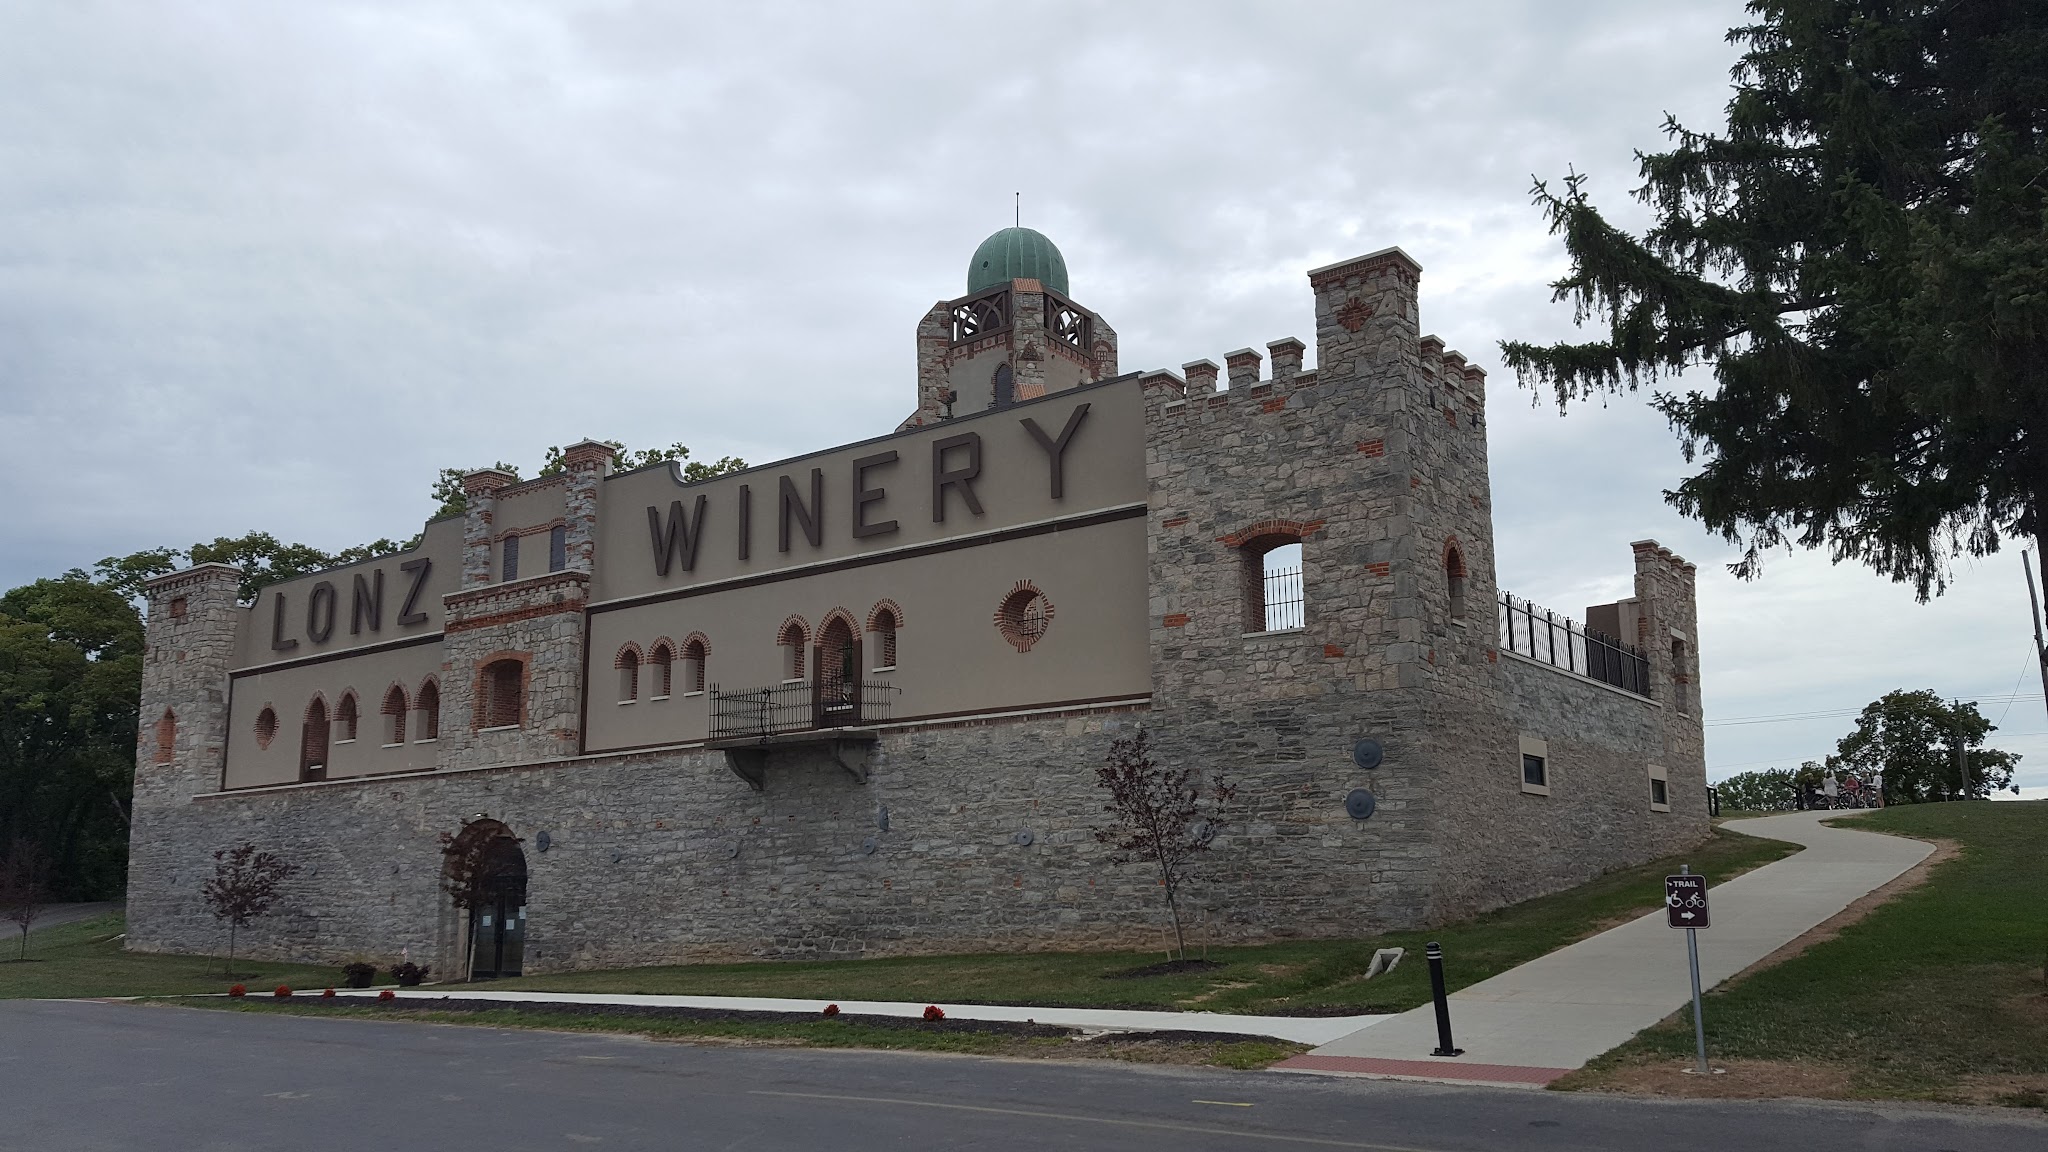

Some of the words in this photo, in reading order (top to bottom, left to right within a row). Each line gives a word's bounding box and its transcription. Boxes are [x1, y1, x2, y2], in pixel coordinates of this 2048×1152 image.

[271, 557, 431, 650] LONZ
[647, 403, 1091, 576] WINERY
[1673, 880, 1698, 888] TRAIL
